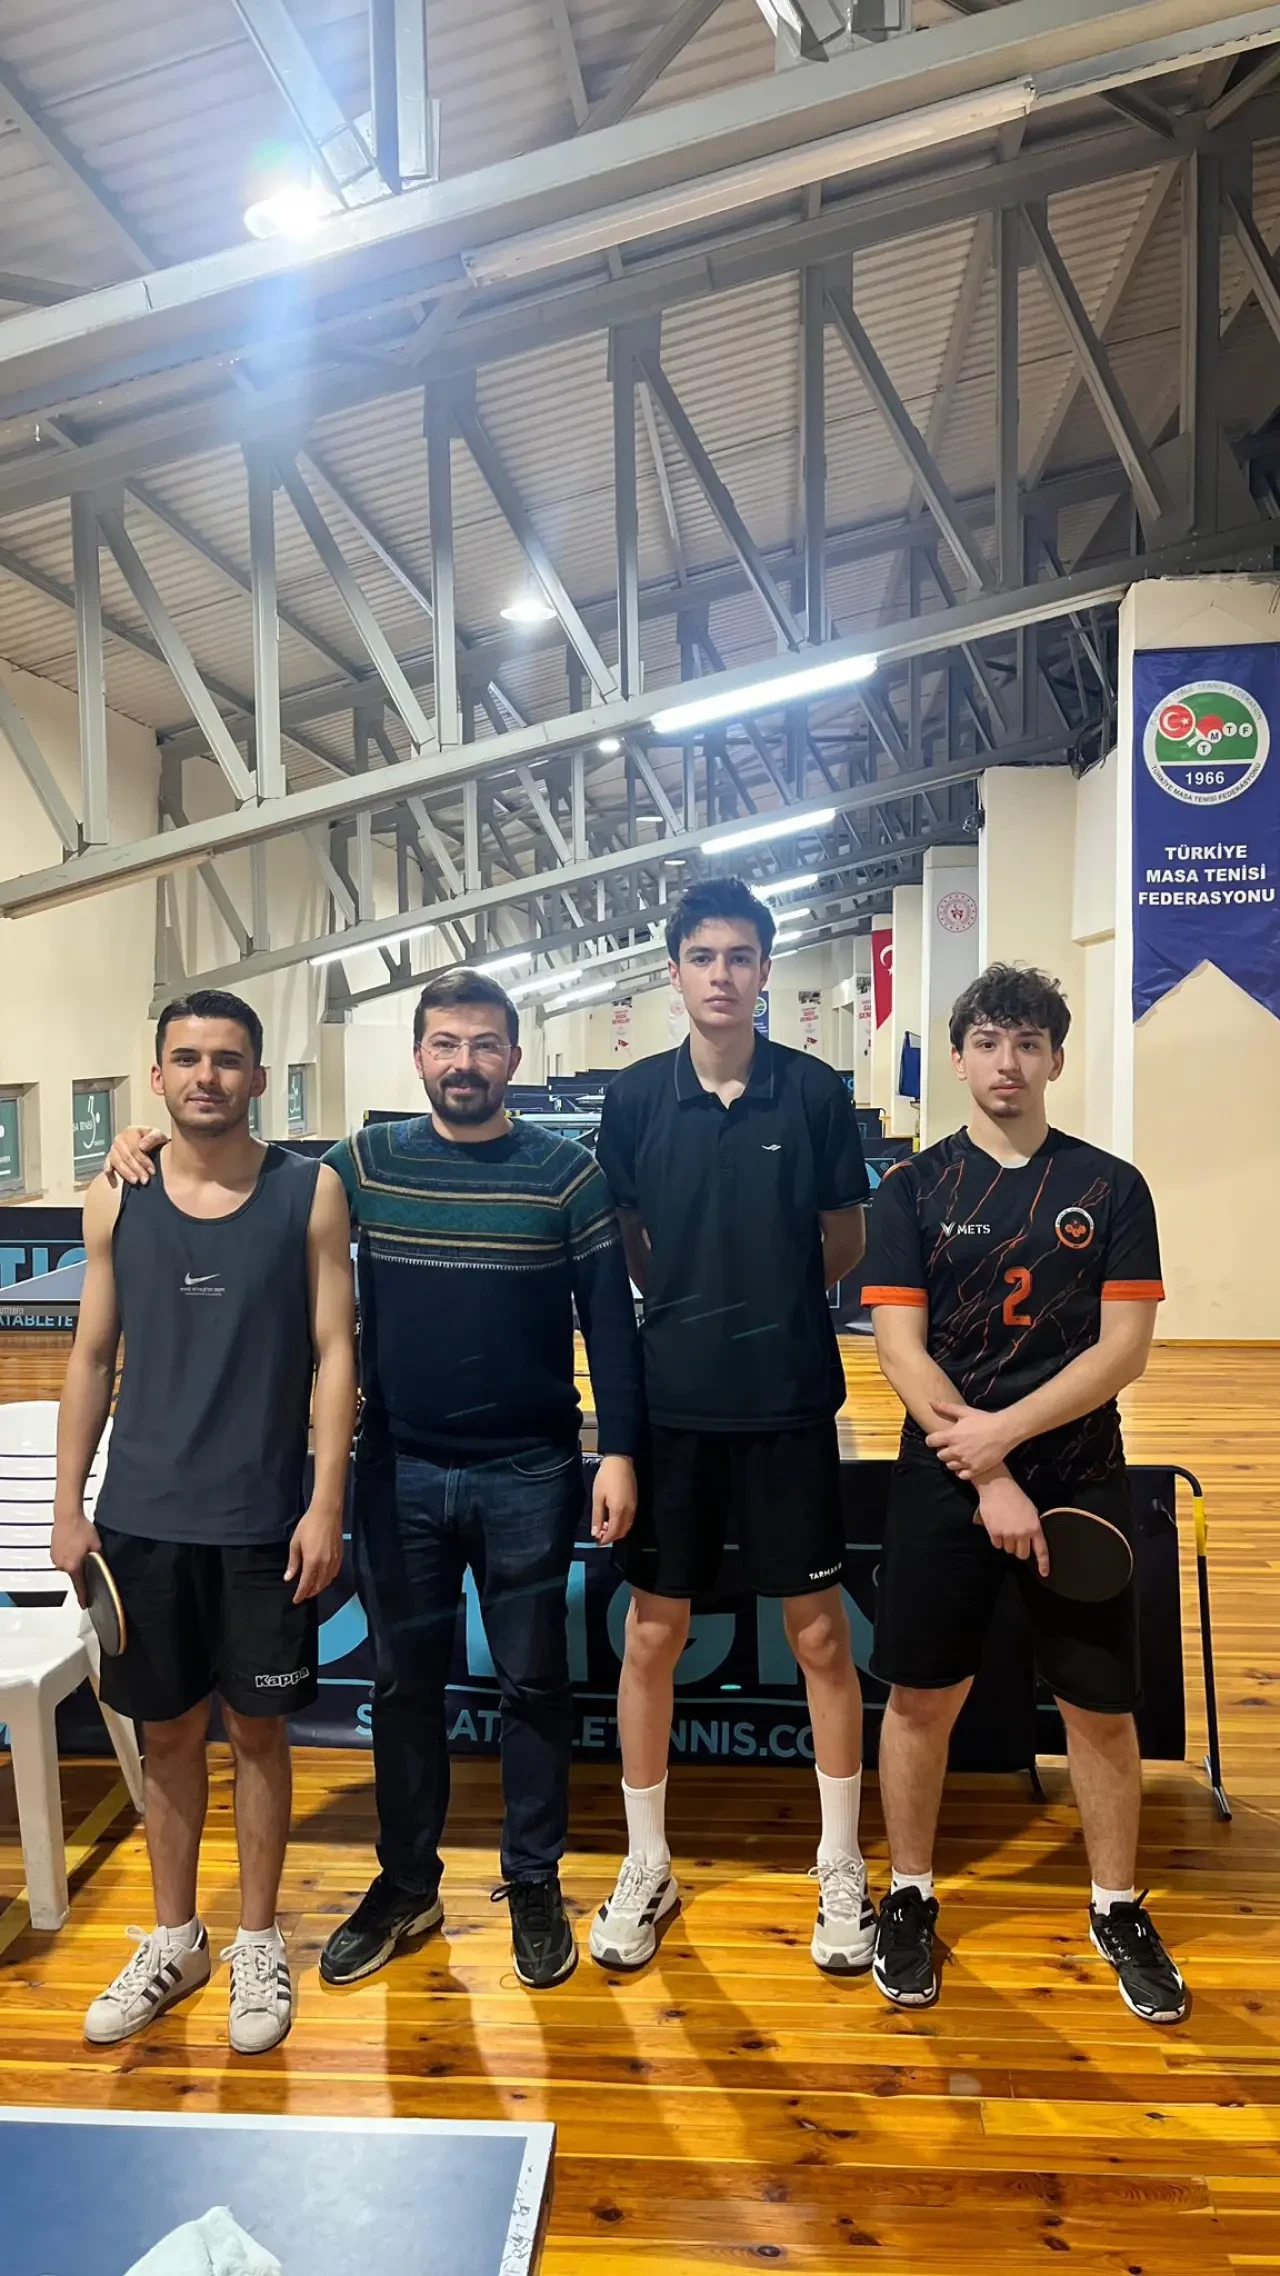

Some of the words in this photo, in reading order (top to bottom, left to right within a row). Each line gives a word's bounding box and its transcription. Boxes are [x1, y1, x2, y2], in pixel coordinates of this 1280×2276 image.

[1185, 771, 1225, 785] 1966
[1173, 788, 1193, 801] MASA
[1165, 842, 1248, 860] TÜRKİYE
[1146, 869, 1199, 883] MASA
[1204, 863, 1266, 882] TENİSİ
[1138, 888, 1275, 906] FEDERASYONU
[957, 1224, 991, 1235] METS
[1003, 1266, 1033, 1326] 2
[255, 1667, 310, 1688] Kappa
